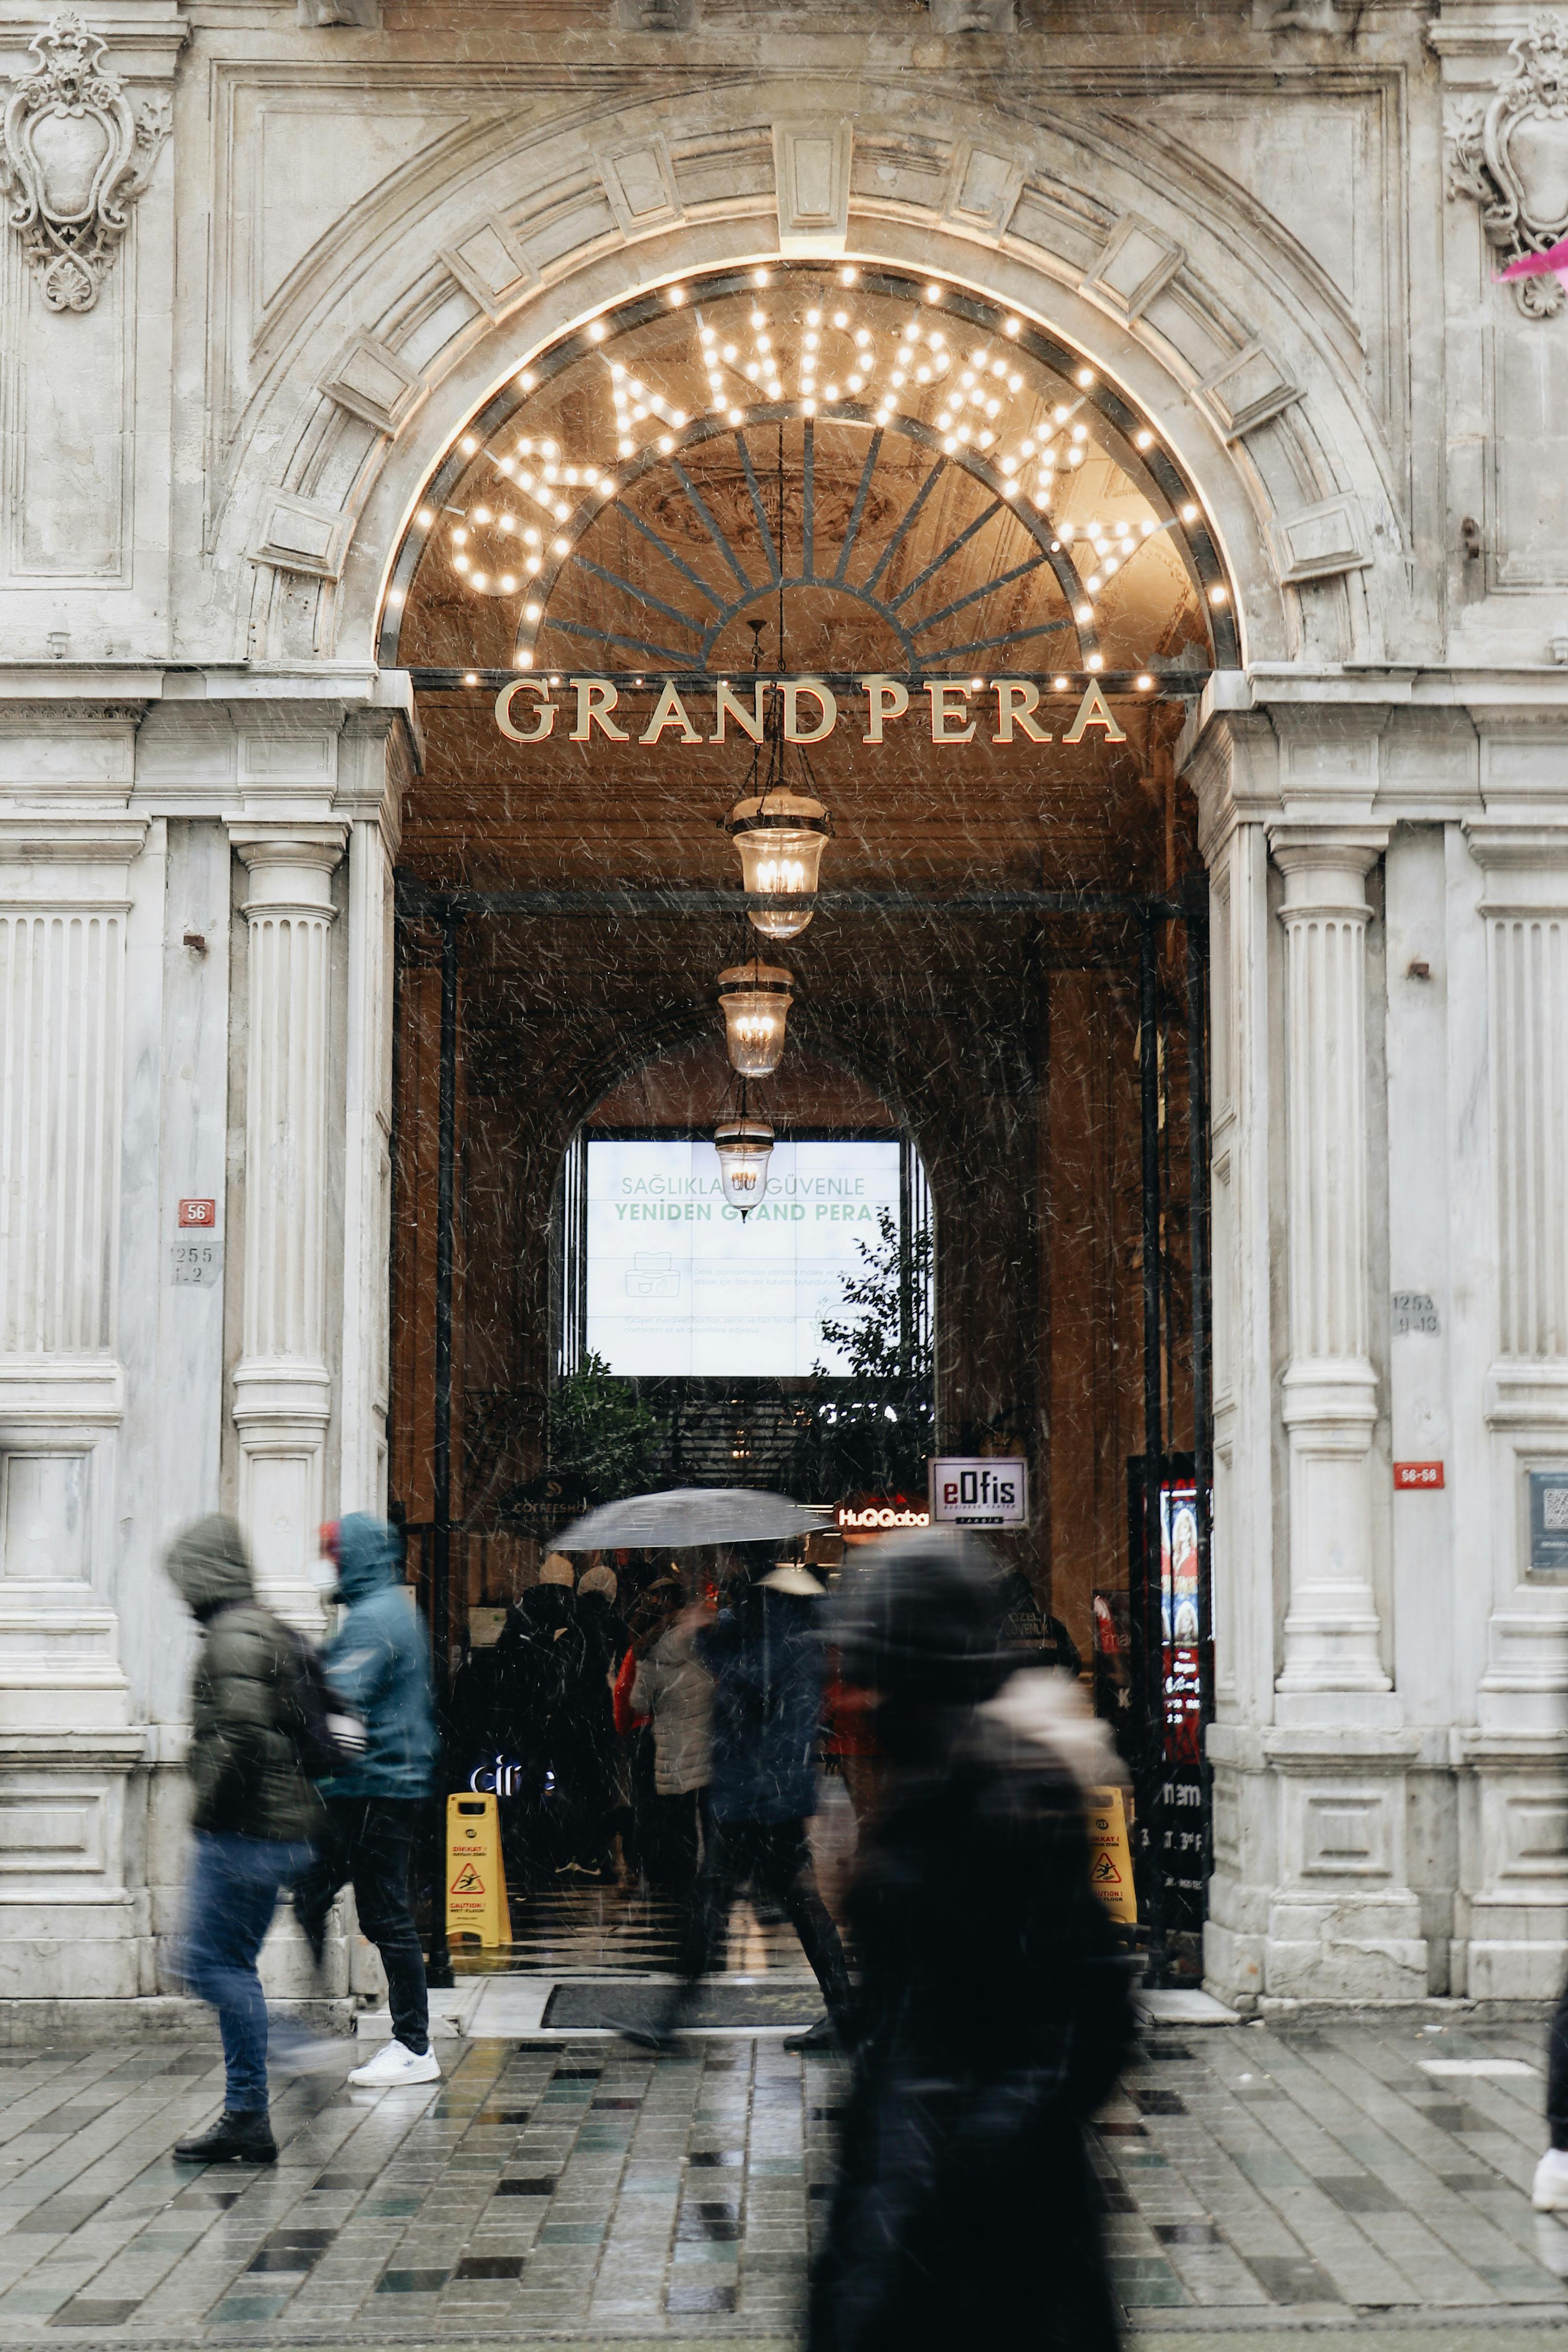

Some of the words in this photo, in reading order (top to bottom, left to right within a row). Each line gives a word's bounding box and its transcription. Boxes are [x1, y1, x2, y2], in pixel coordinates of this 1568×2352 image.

[882, 322, 1154, 592] PERA
[495, 678, 837, 743] GRAND
[862, 678, 1126, 743] PERA
[622, 1173, 724, 1194] SAĞLIKLA
[766, 1174, 864, 1195] GÜVENLE
[188, 1205, 205, 1220] 56
[615, 1199, 711, 1220] YENİDEN
[816, 1204, 873, 1221] PERA
[1401, 1469, 1437, 1482] 56-58
[944, 1471, 1014, 1504] eOfis
[839, 1508, 930, 1527] HuQQaba
